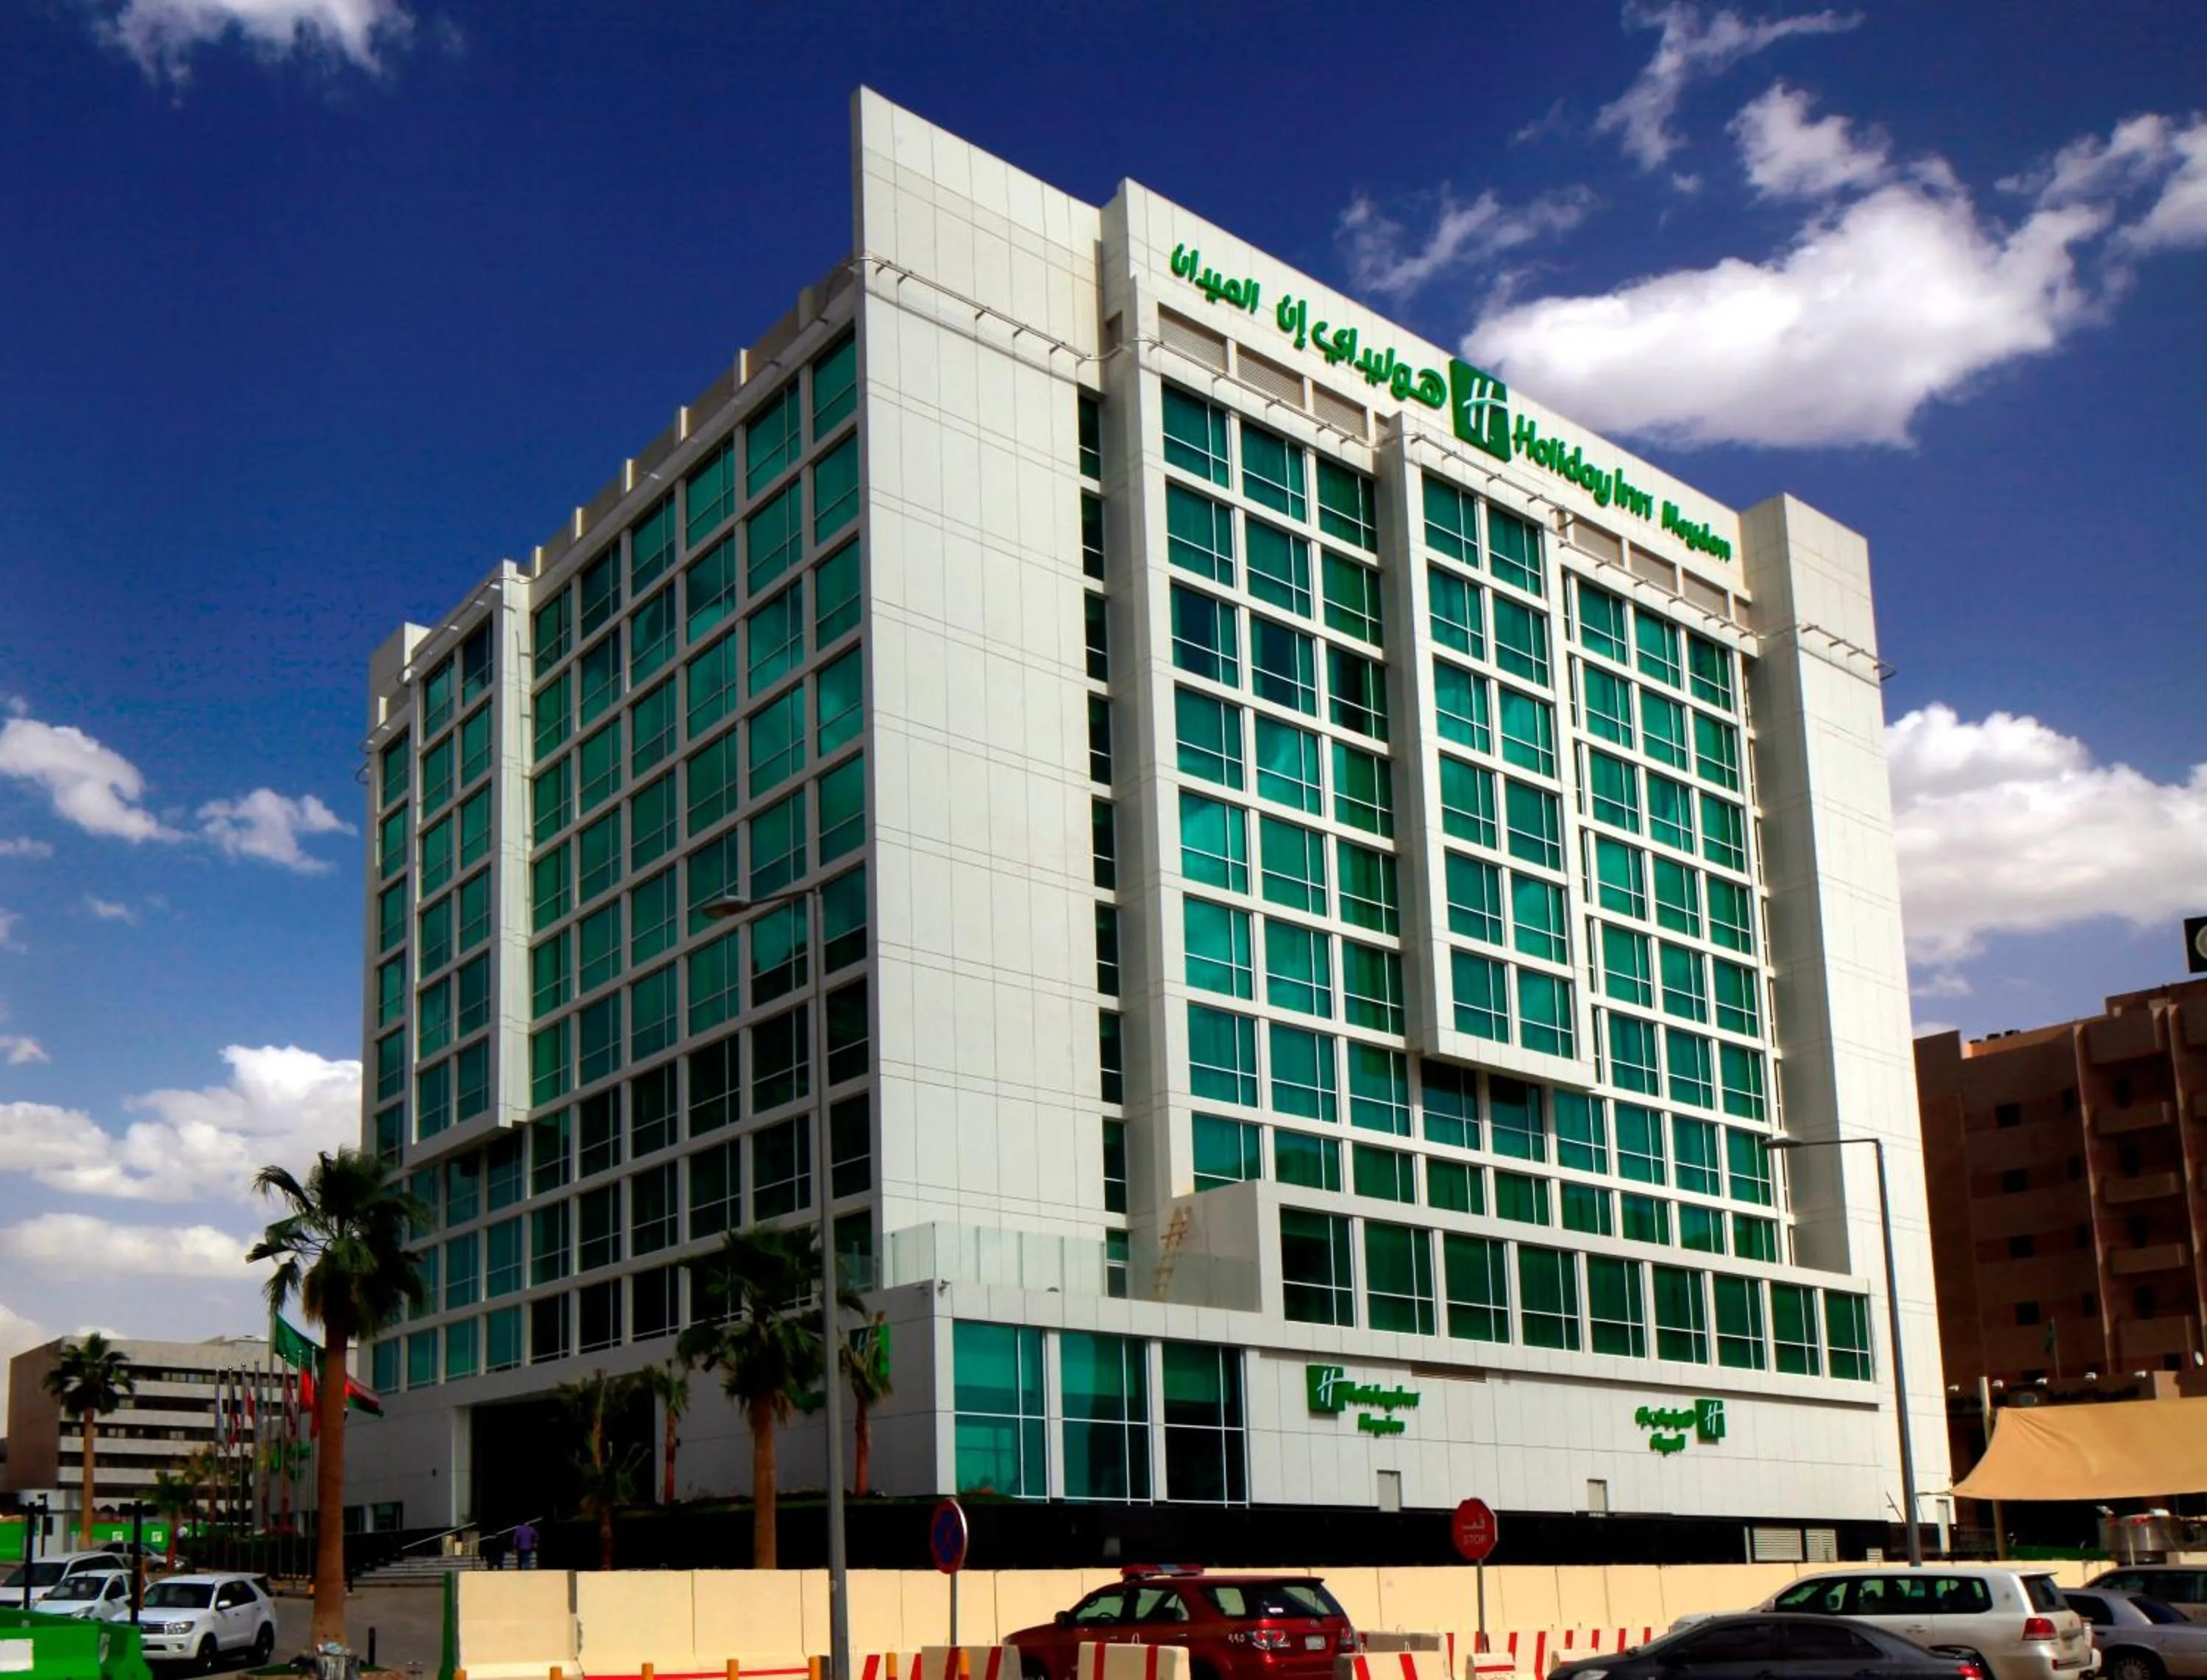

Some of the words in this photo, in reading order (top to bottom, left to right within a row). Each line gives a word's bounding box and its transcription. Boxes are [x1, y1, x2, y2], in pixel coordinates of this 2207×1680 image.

[1170, 243, 1259, 315] الميدان
[1312, 314, 1447, 410] هوليداي
[1513, 414, 1612, 508] Holiday
[1614, 467, 1653, 522] Inn
[1463, 1534, 1488, 1545] STOP
